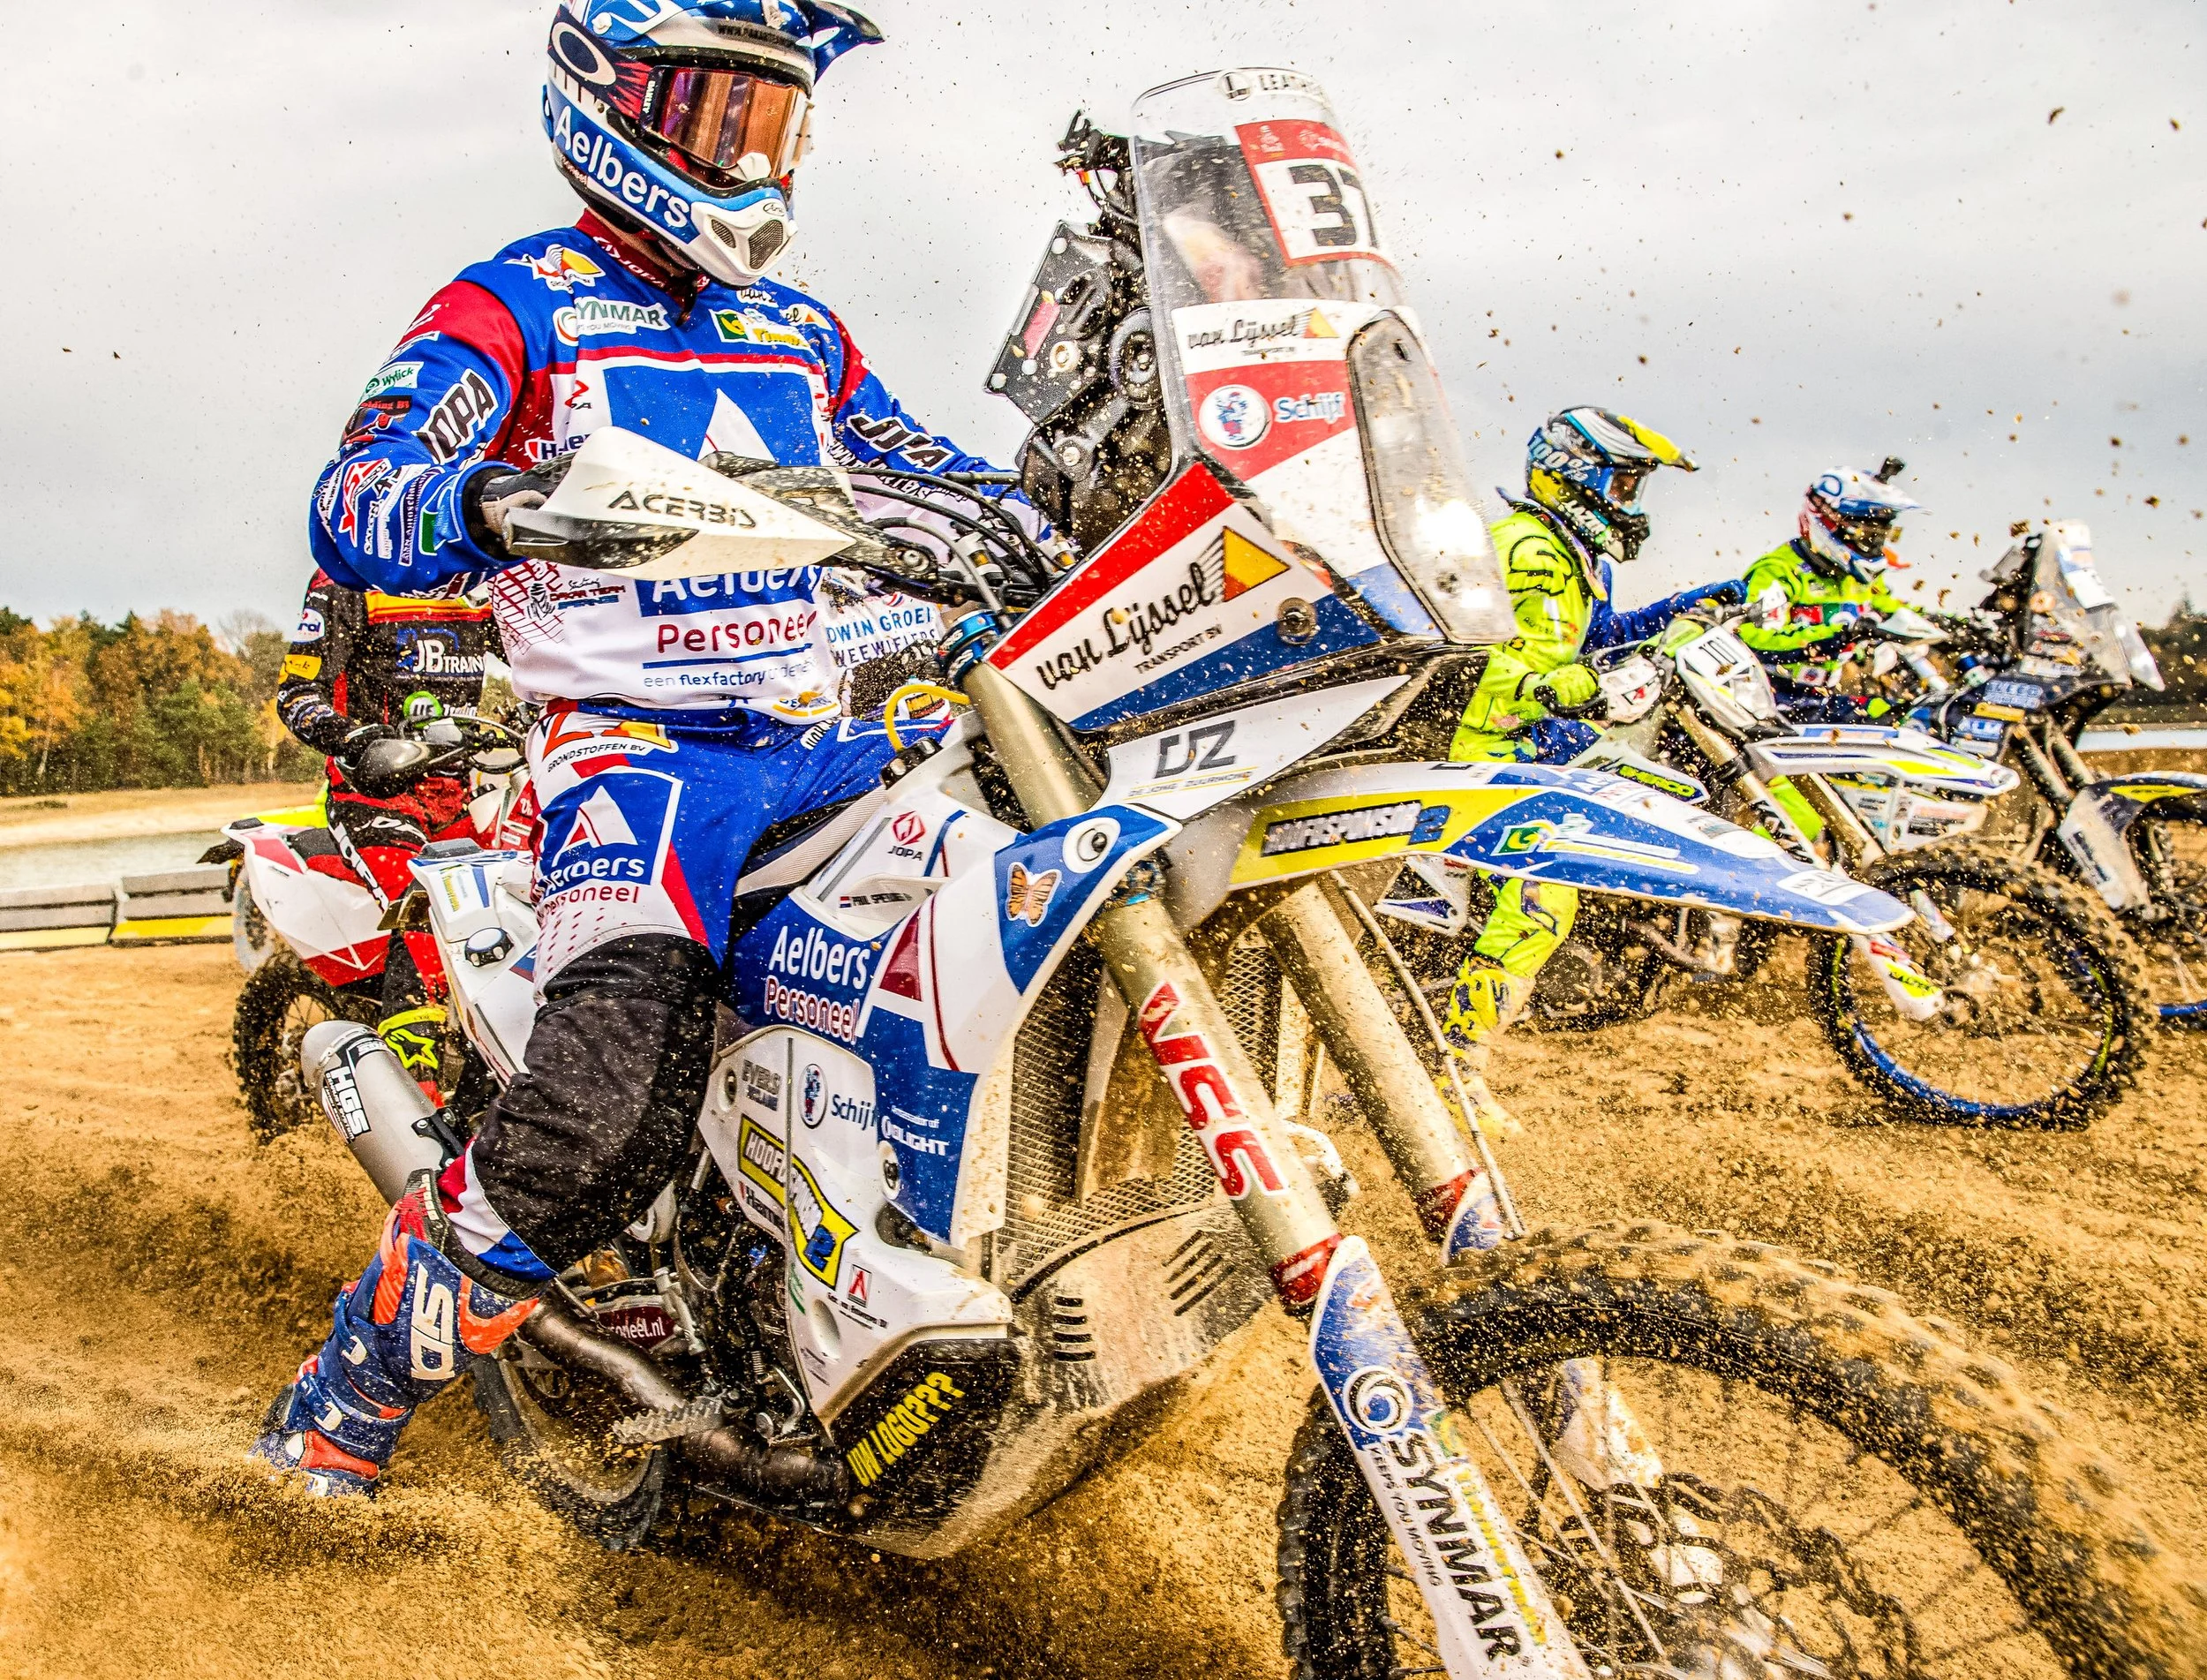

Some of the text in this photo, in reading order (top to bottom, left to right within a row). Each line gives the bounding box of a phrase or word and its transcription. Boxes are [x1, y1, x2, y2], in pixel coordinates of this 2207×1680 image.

[554, 105, 690, 228] Aelbers
[607, 490, 757, 530] ACERBIS
[1036, 644, 1103, 690] van
[1134, 623, 1224, 675] TRANSPORT BV
[644, 676, 675, 687] een
[887, 845, 923, 862] JOPA
[768, 924, 872, 991] Aelbers
[765, 976, 861, 1045] Personeel
[329, 1066, 371, 1136] HGS
[1387, 1431, 1523, 1662] SYNMAR
